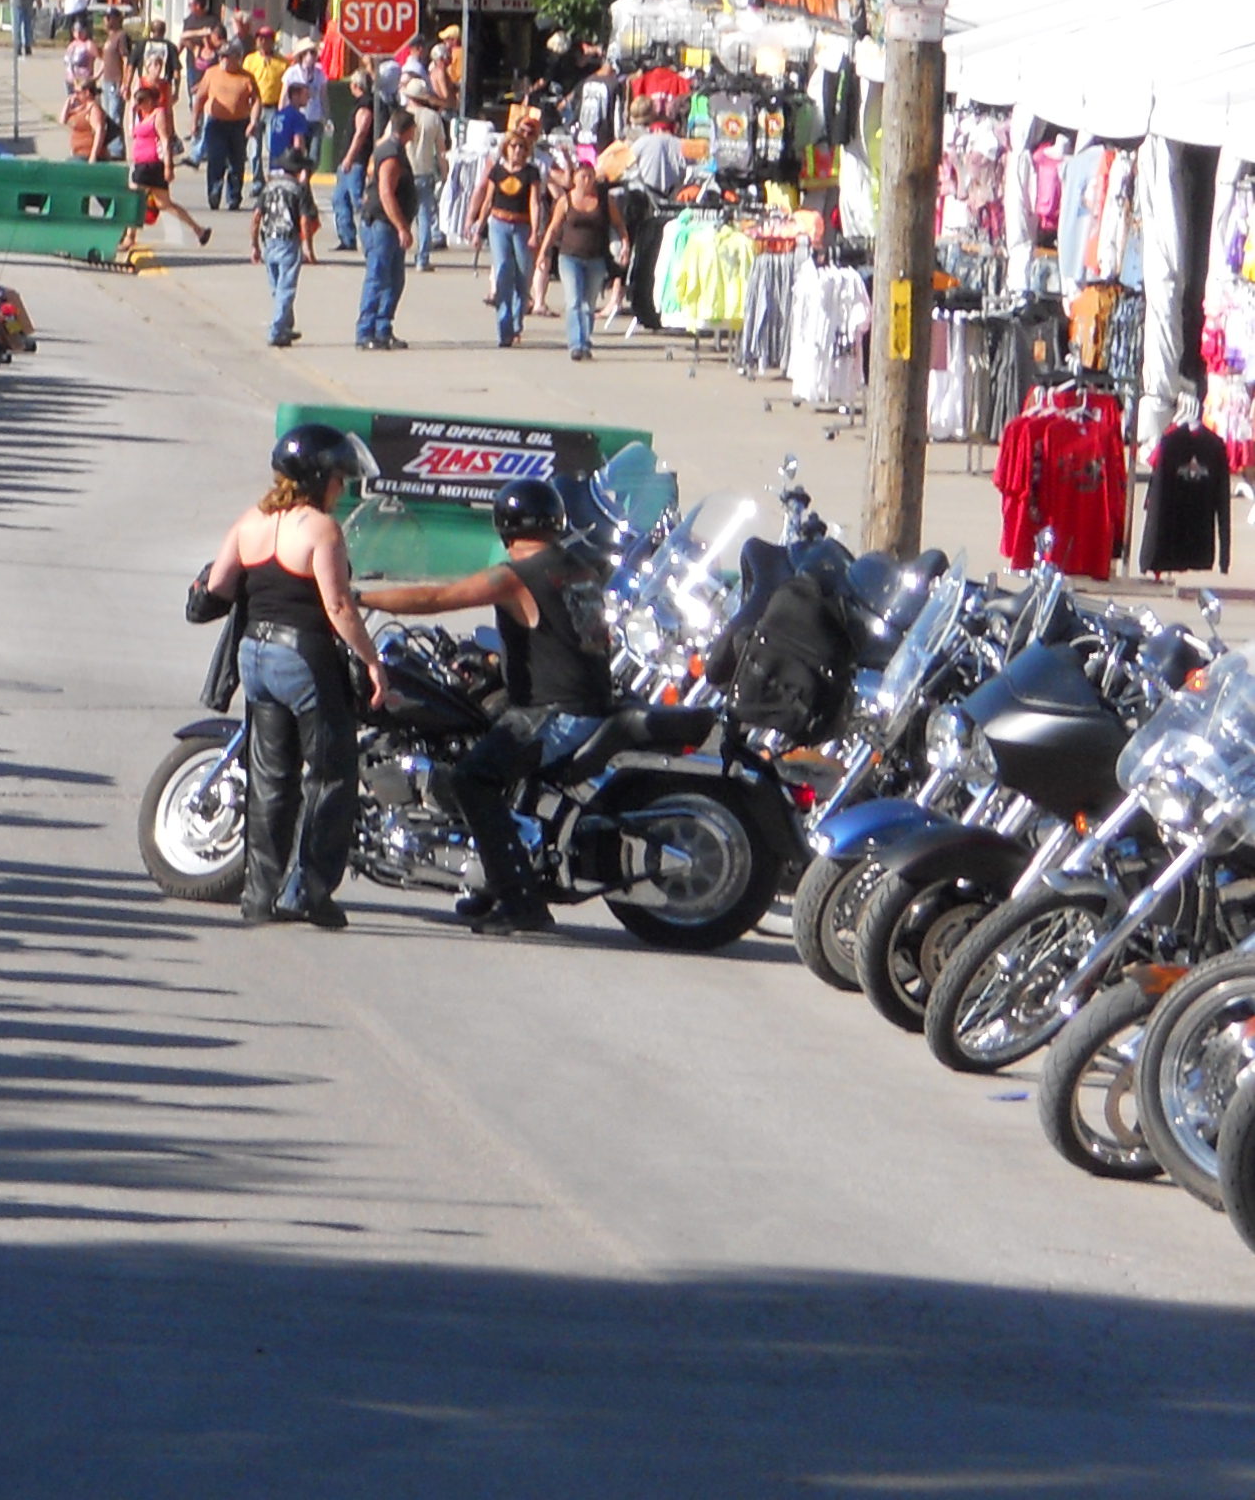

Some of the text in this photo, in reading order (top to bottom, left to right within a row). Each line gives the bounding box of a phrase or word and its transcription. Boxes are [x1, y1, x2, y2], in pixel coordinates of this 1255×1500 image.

[345, 2, 413, 32] STOP
[409, 422, 553, 447] THE OFFICIAL OIL
[403, 441, 555, 481] AMSOIL
[375, 479, 434, 495] STURGIS
